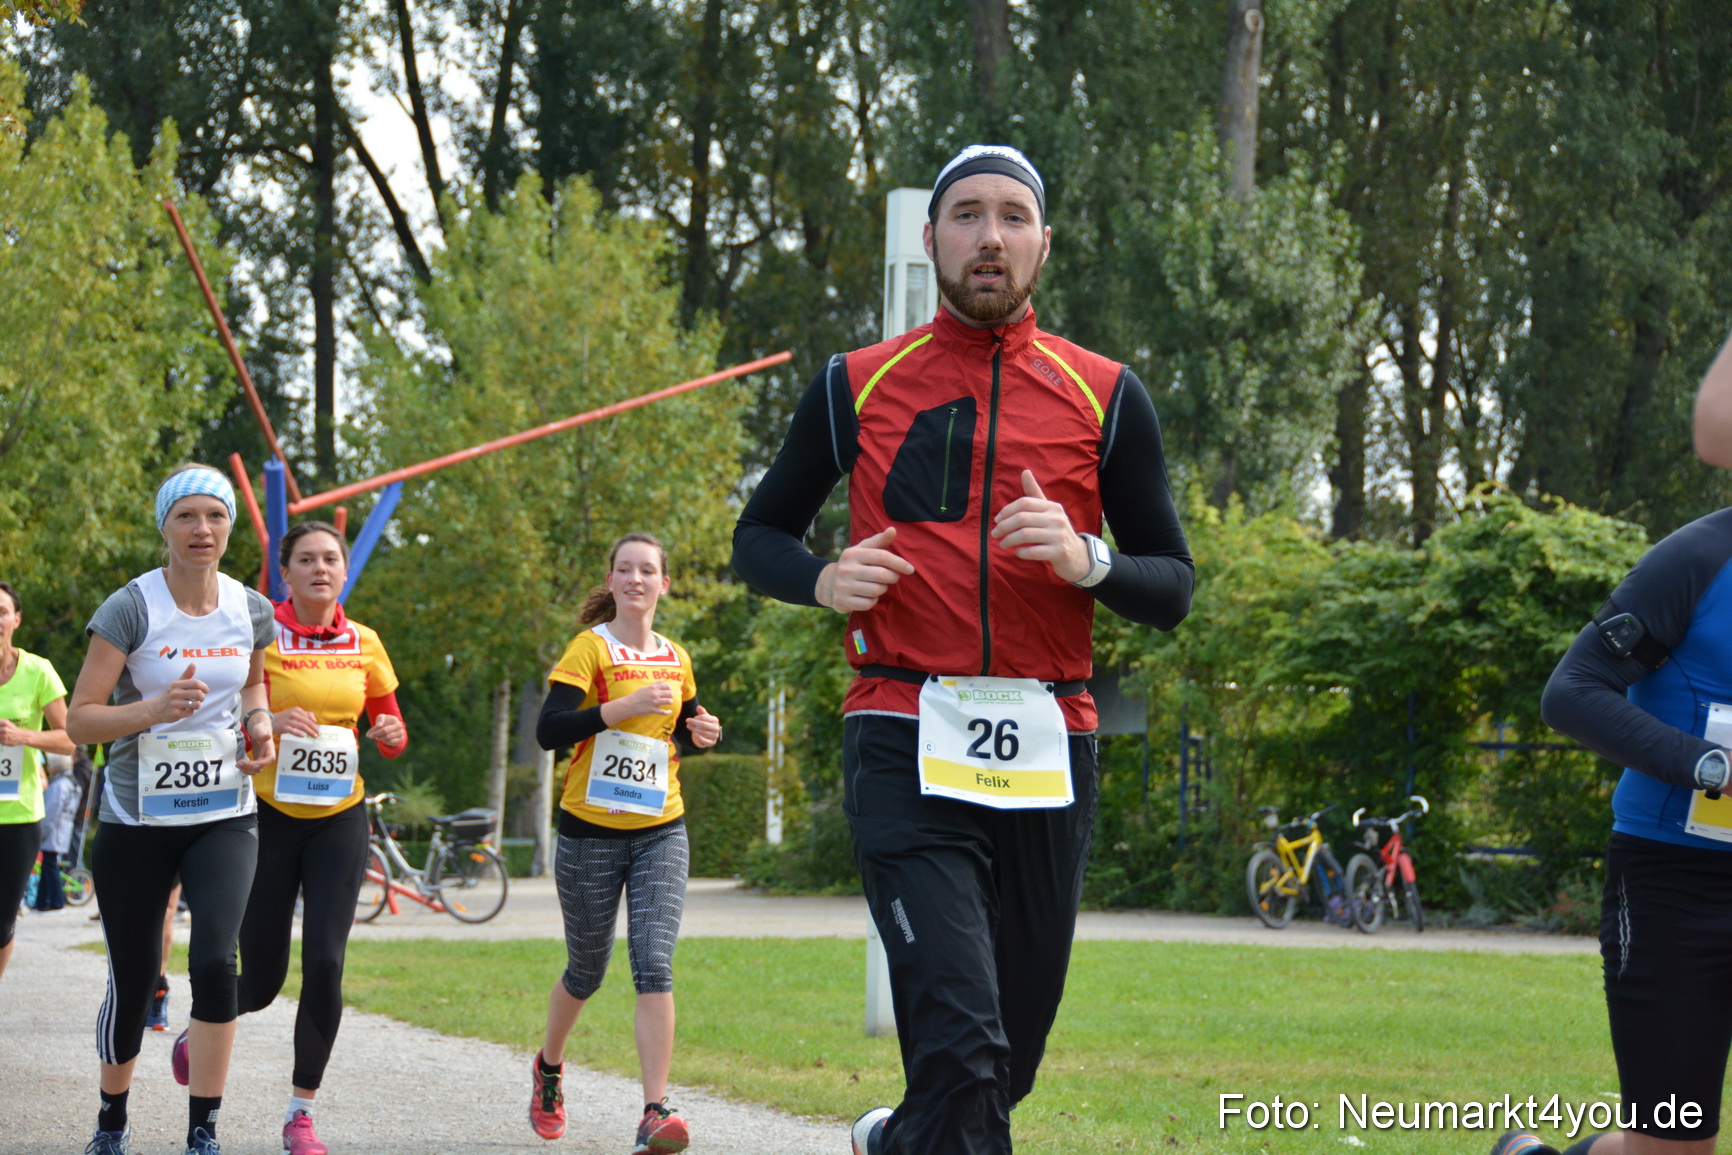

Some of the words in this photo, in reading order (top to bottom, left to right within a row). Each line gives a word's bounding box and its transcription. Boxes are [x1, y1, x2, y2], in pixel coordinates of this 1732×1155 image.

[1033, 358, 1063, 386] GORE
[182, 647, 243, 658] KLEBL
[281, 659, 320, 671] MAX
[613, 669, 649, 682] MAX
[652, 668, 682, 682] BÖGL
[972, 689, 1024, 702] BOCK
[178, 739, 212, 748] BOCK
[966, 718, 1020, 762] 26
[291, 748, 347, 775] 2635
[154, 759, 223, 790] 2387
[602, 754, 657, 785] 2634
[307, 781, 330, 792] Luisa
[975, 773, 1011, 788] Felix
[613, 786, 643, 800] Sandra
[173, 796, 209, 809] Kerstin
